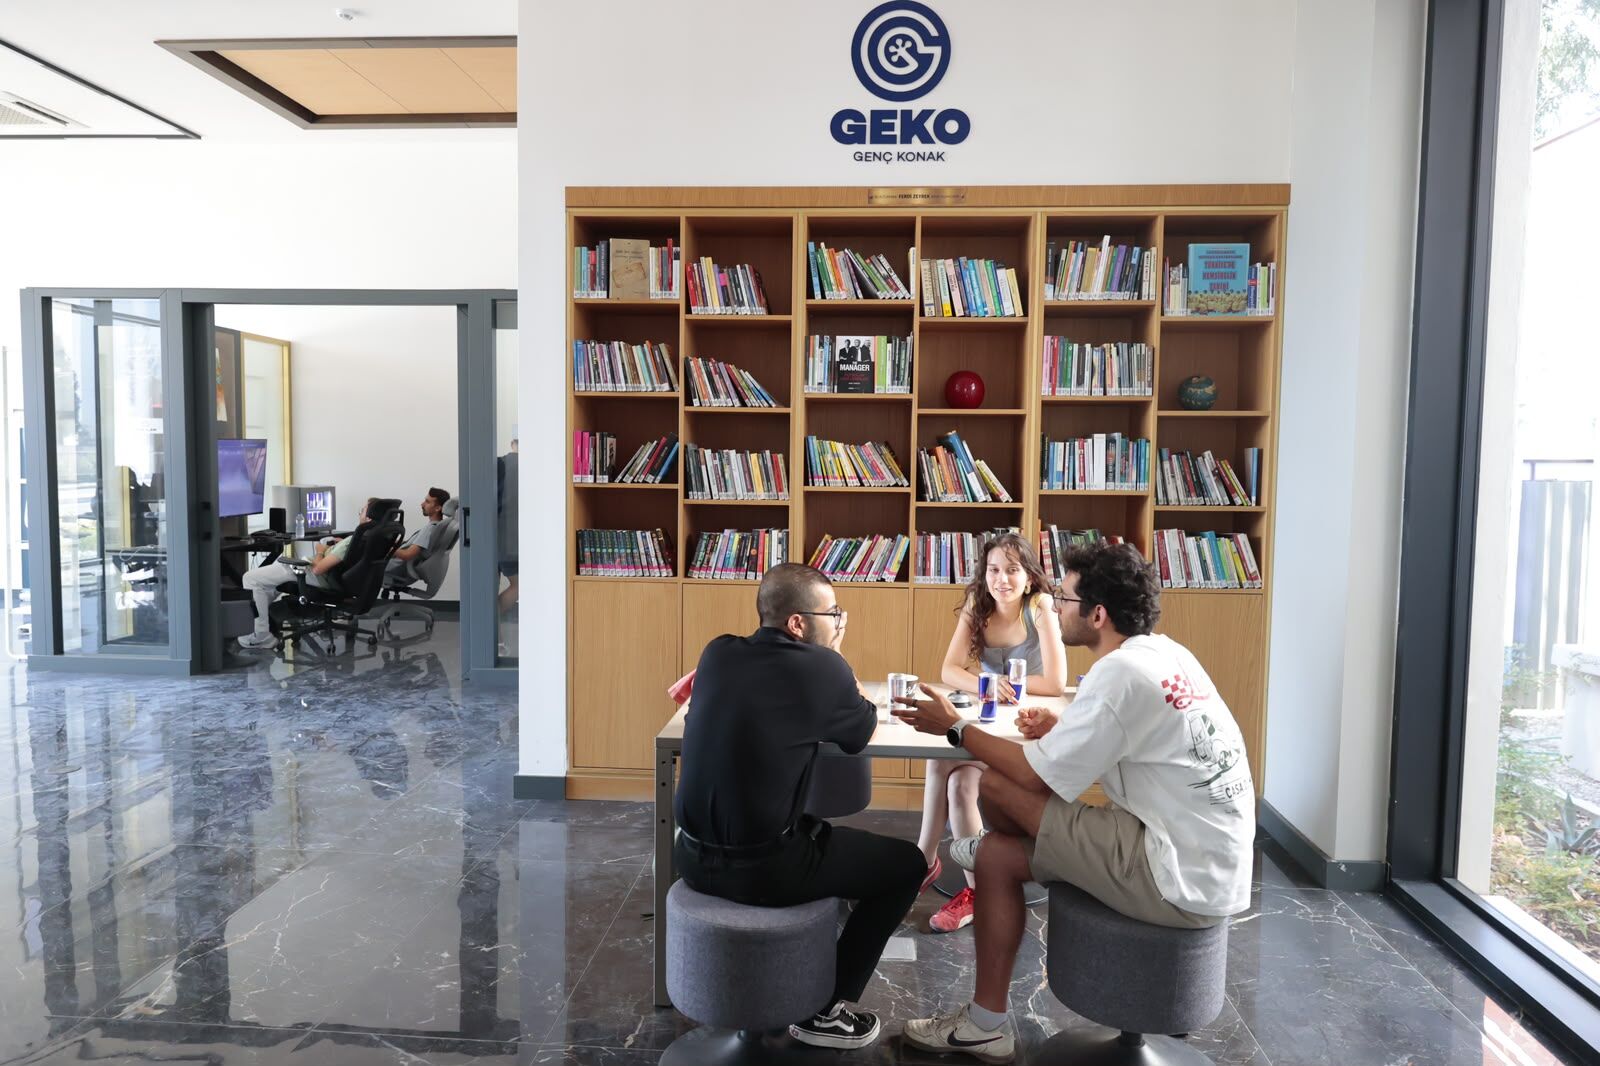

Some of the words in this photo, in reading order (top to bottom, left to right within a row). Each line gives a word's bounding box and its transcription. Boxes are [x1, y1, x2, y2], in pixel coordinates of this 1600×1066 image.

[830, 108, 971, 145] GEKO
[853, 151, 893, 164] GENÇ
[897, 151, 945, 162] KONAK
